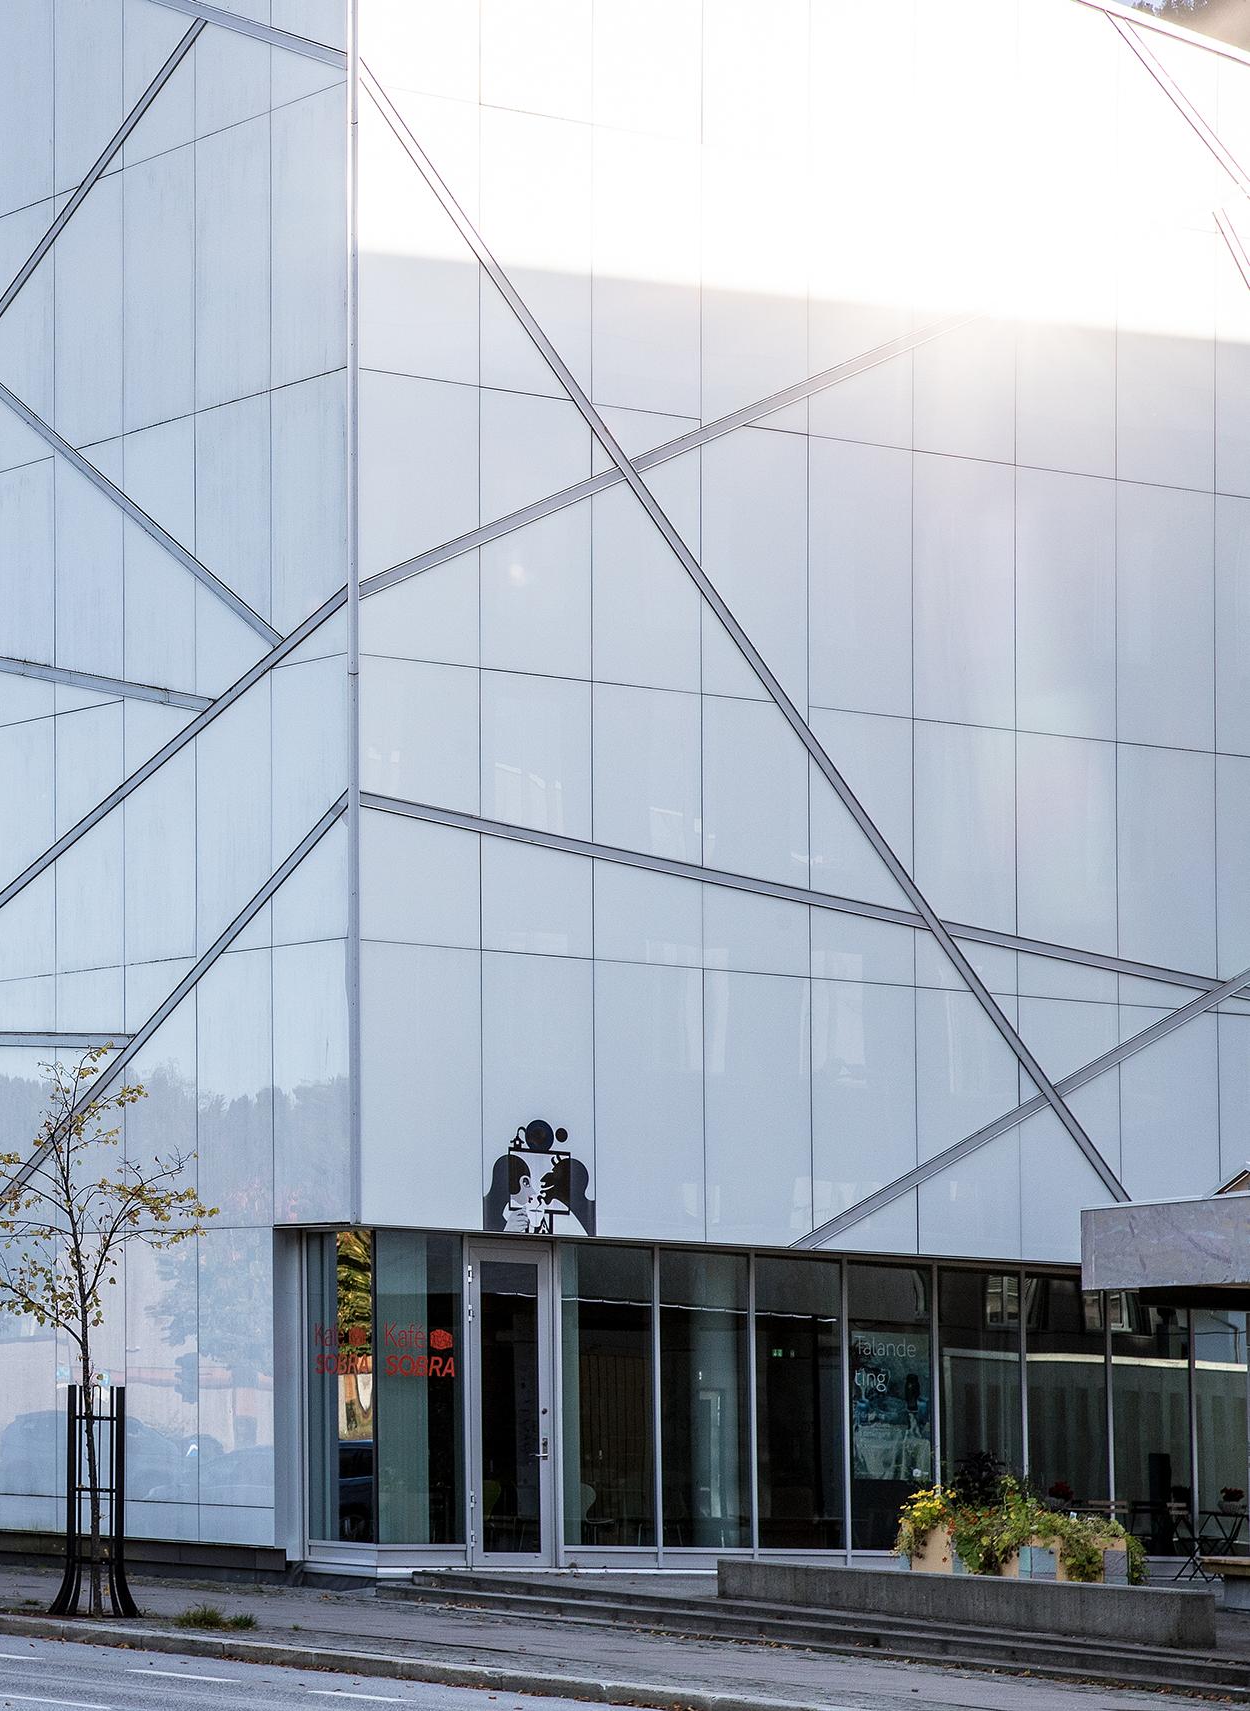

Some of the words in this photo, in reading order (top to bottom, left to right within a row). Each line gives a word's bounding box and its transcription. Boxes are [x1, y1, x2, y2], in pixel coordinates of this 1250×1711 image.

[384, 1321, 426, 1347] Kafé
[854, 1335, 917, 1358] Talande
[315, 1353, 369, 1374] SOBRA
[385, 1355, 456, 1377] SOBRA
[855, 1367, 887, 1392] ting
